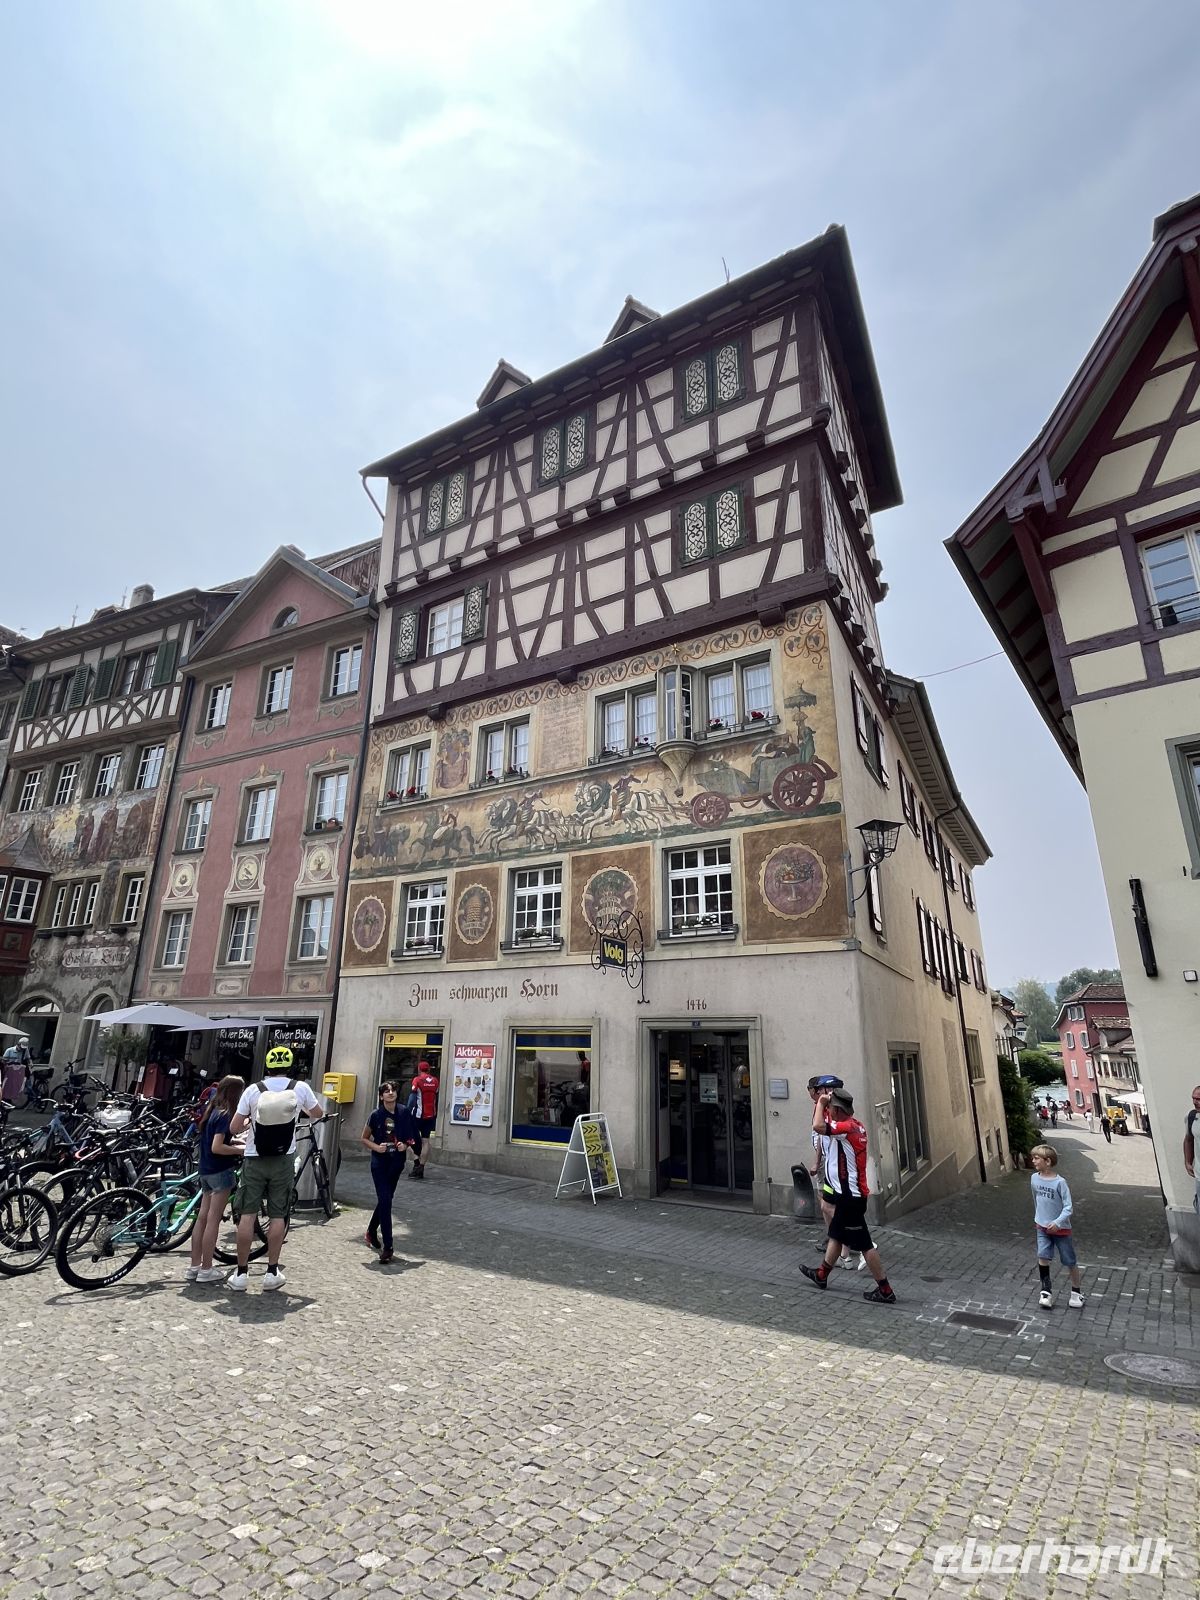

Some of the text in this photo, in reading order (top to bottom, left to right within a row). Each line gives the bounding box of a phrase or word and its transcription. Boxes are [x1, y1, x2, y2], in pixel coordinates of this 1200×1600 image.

[603, 941, 624, 965] Volg
[408, 978, 559, 1008] Zum schwarzen Horn
[687, 999, 707, 1011] 1476
[238, 1028, 254, 1039] Bike
[274, 1028, 312, 1040] River Bike
[456, 1046, 483, 1057] Aktion
